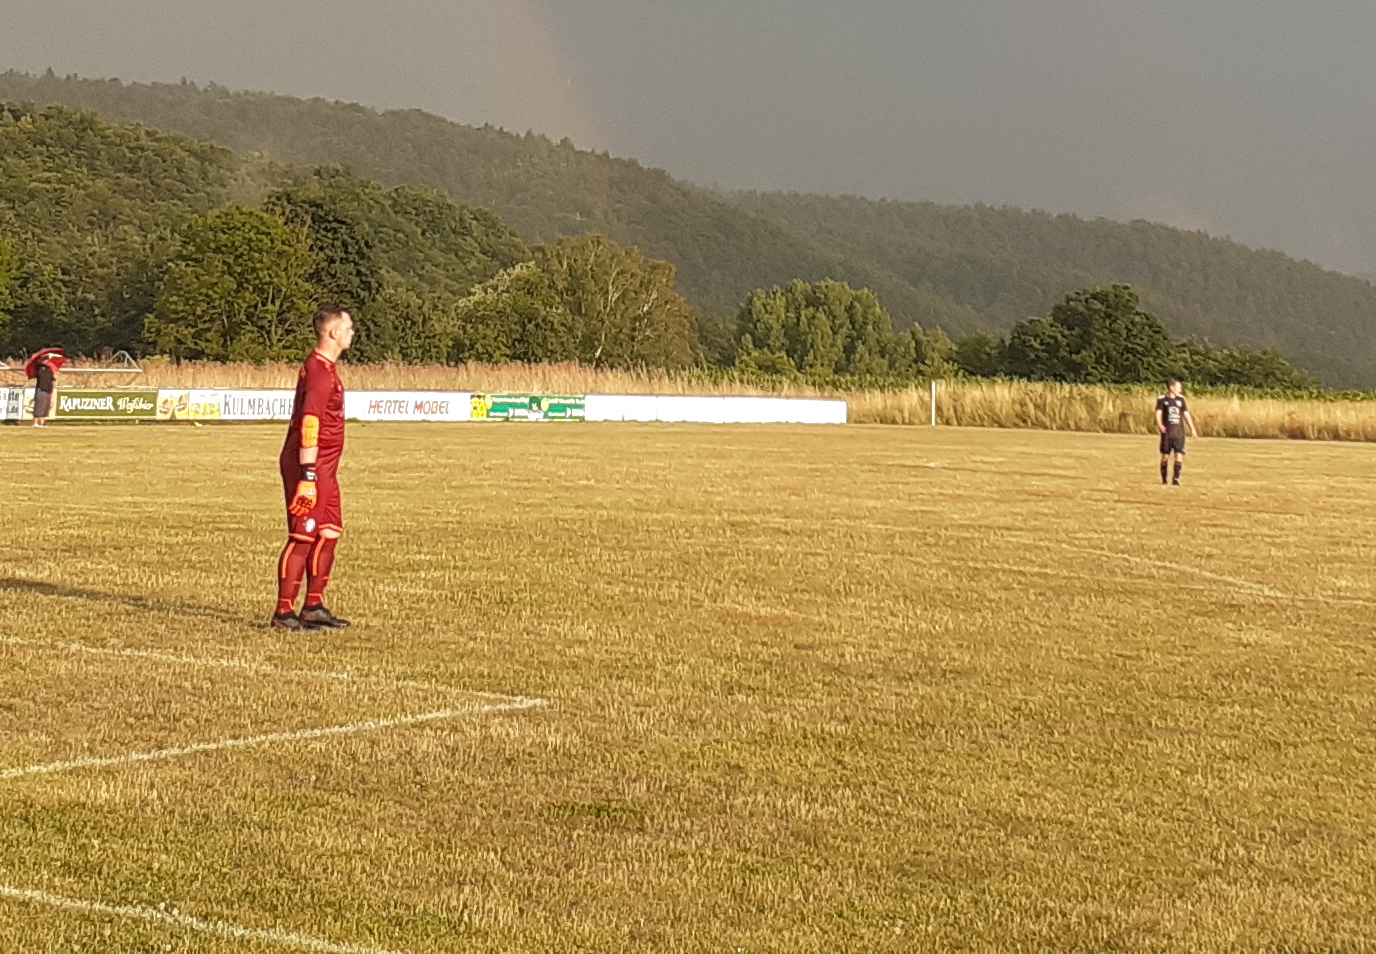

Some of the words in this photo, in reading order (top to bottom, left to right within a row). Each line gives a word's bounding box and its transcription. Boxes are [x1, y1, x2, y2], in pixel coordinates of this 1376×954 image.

[59, 396, 115, 412] KAPUZINER
[222, 394, 295, 416] KULMBACHE
[368, 400, 409, 414] HERTEL
